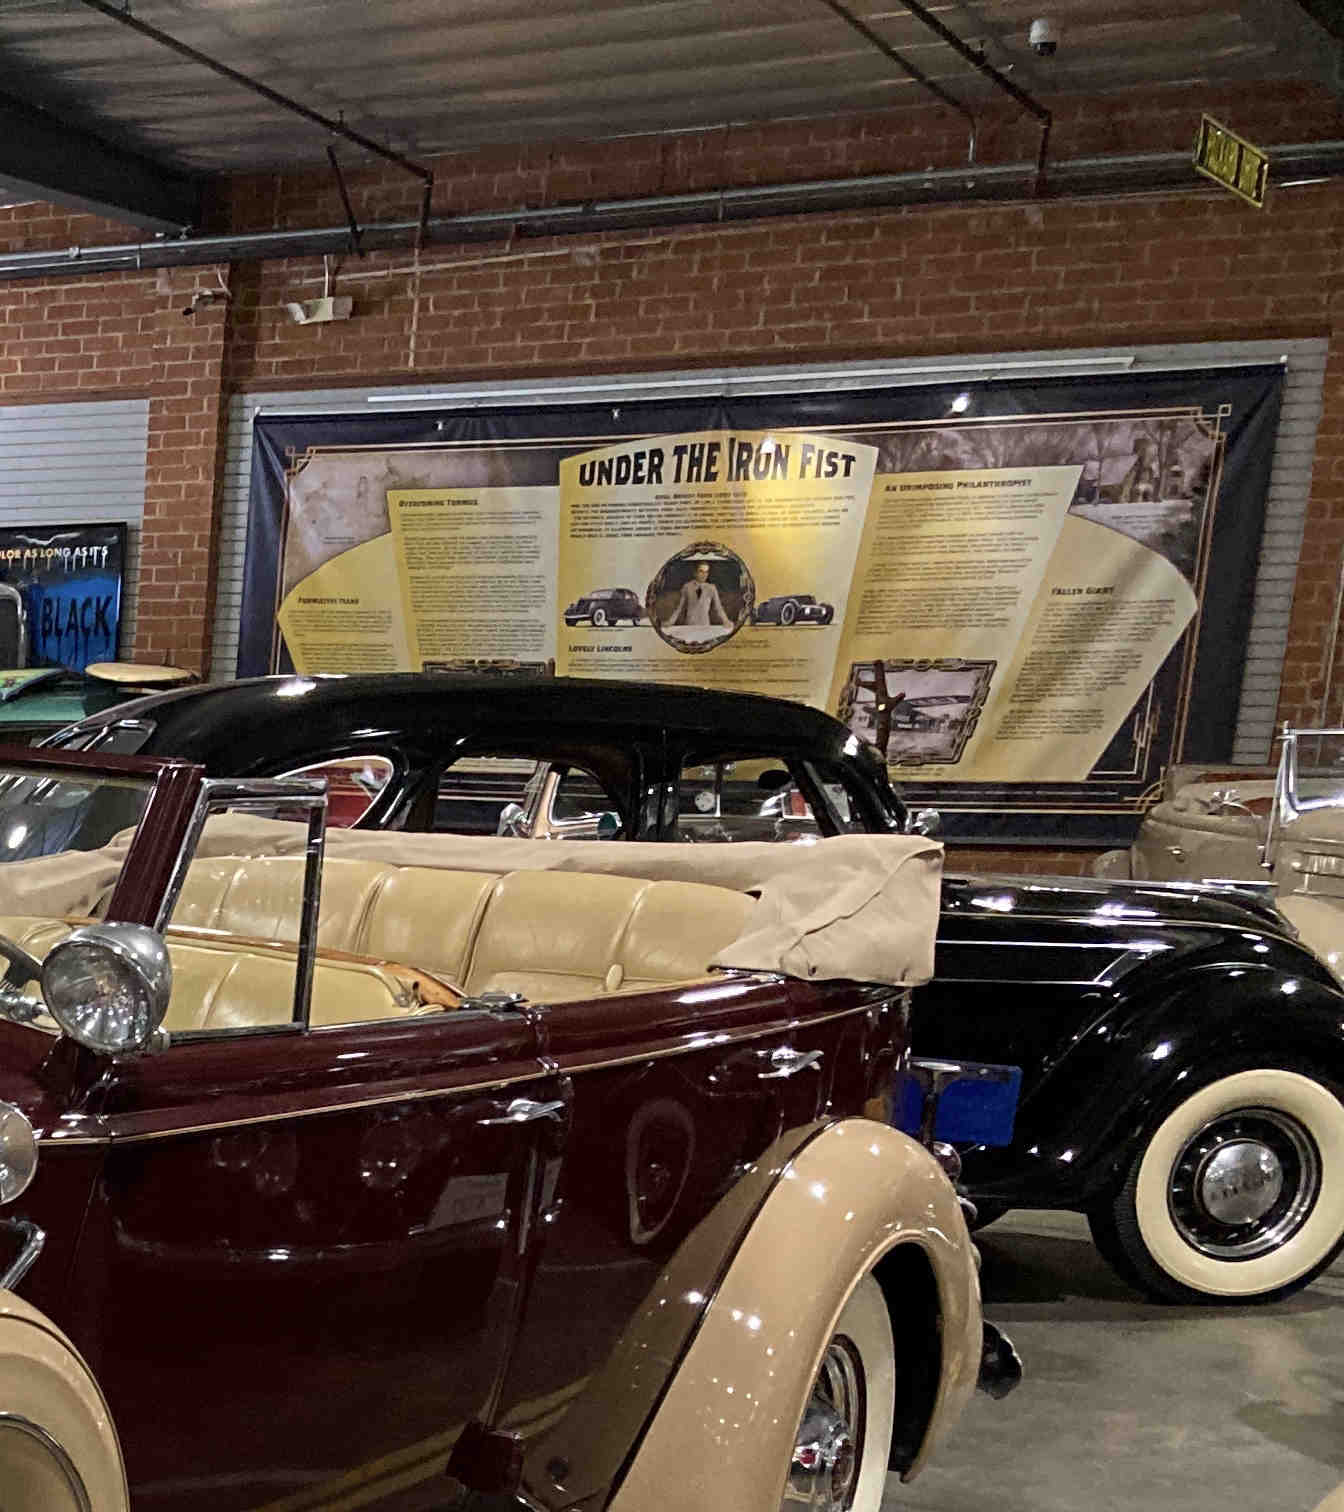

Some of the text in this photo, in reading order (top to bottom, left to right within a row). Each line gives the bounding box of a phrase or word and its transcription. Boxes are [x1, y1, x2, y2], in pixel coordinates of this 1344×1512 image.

[578, 437, 857, 486] UNDER THE IRON FIST
[39, 547, 71, 560] LONG
[40, 596, 113, 640] BLACK
